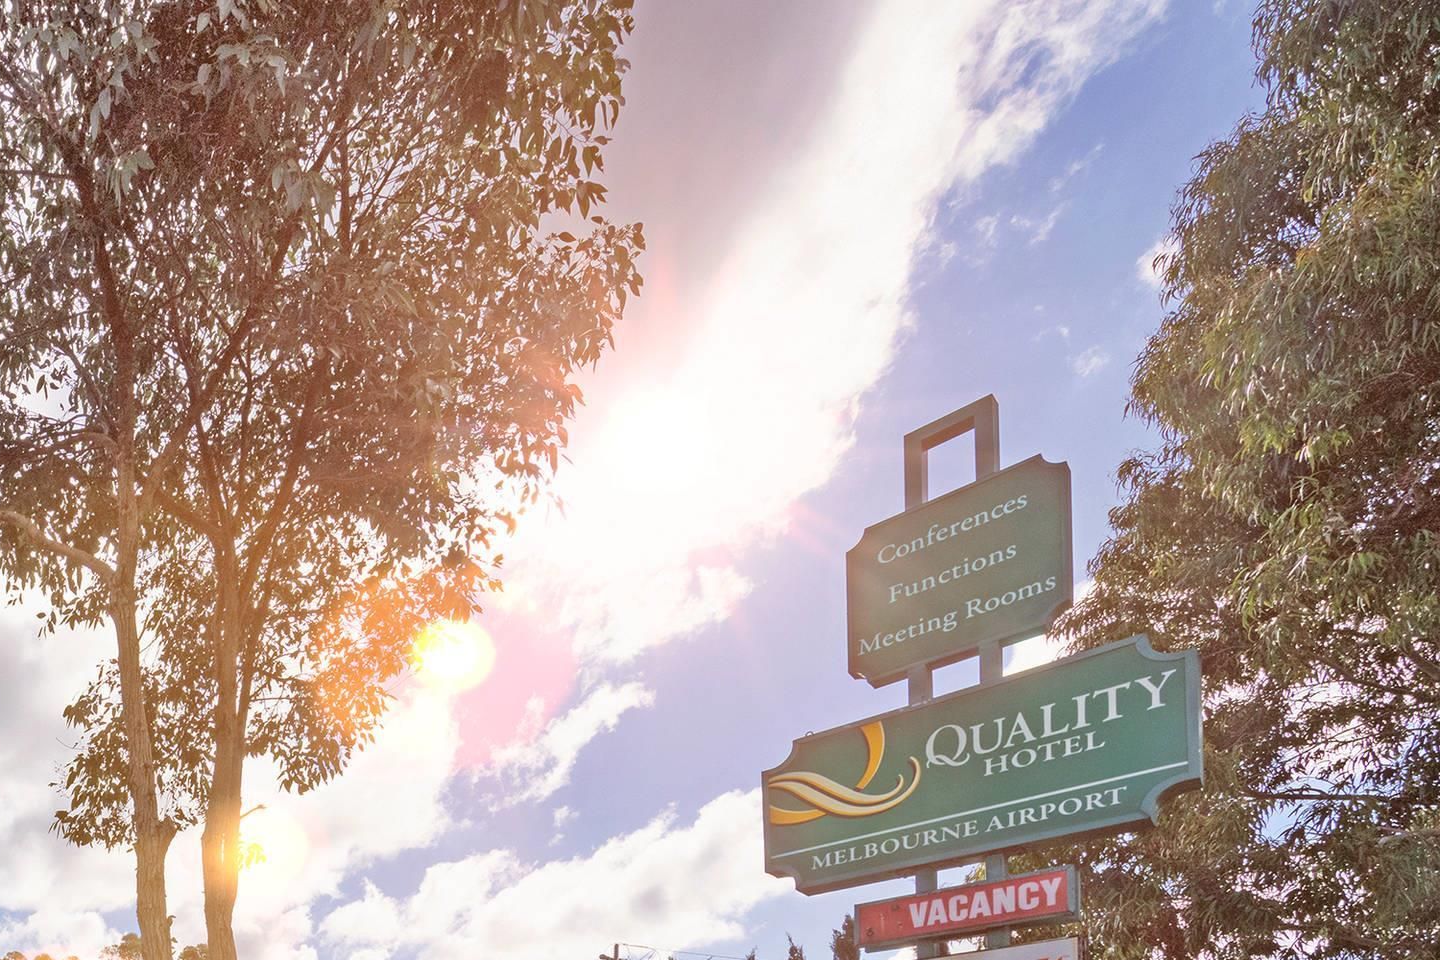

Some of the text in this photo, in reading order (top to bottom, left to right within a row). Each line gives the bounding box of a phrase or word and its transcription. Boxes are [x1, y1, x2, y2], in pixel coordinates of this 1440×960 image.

[877, 493, 1028, 564] Conferences
[889, 543, 1017, 604] Functions
[858, 575, 1057, 656] Meeting Rooms
[925, 669, 1177, 768] QUALITY
[984, 731, 1106, 777] HOTEL
[811, 786, 1127, 871] MELBOURNE AIRPORT
[910, 876, 1062, 929] VACANCY
